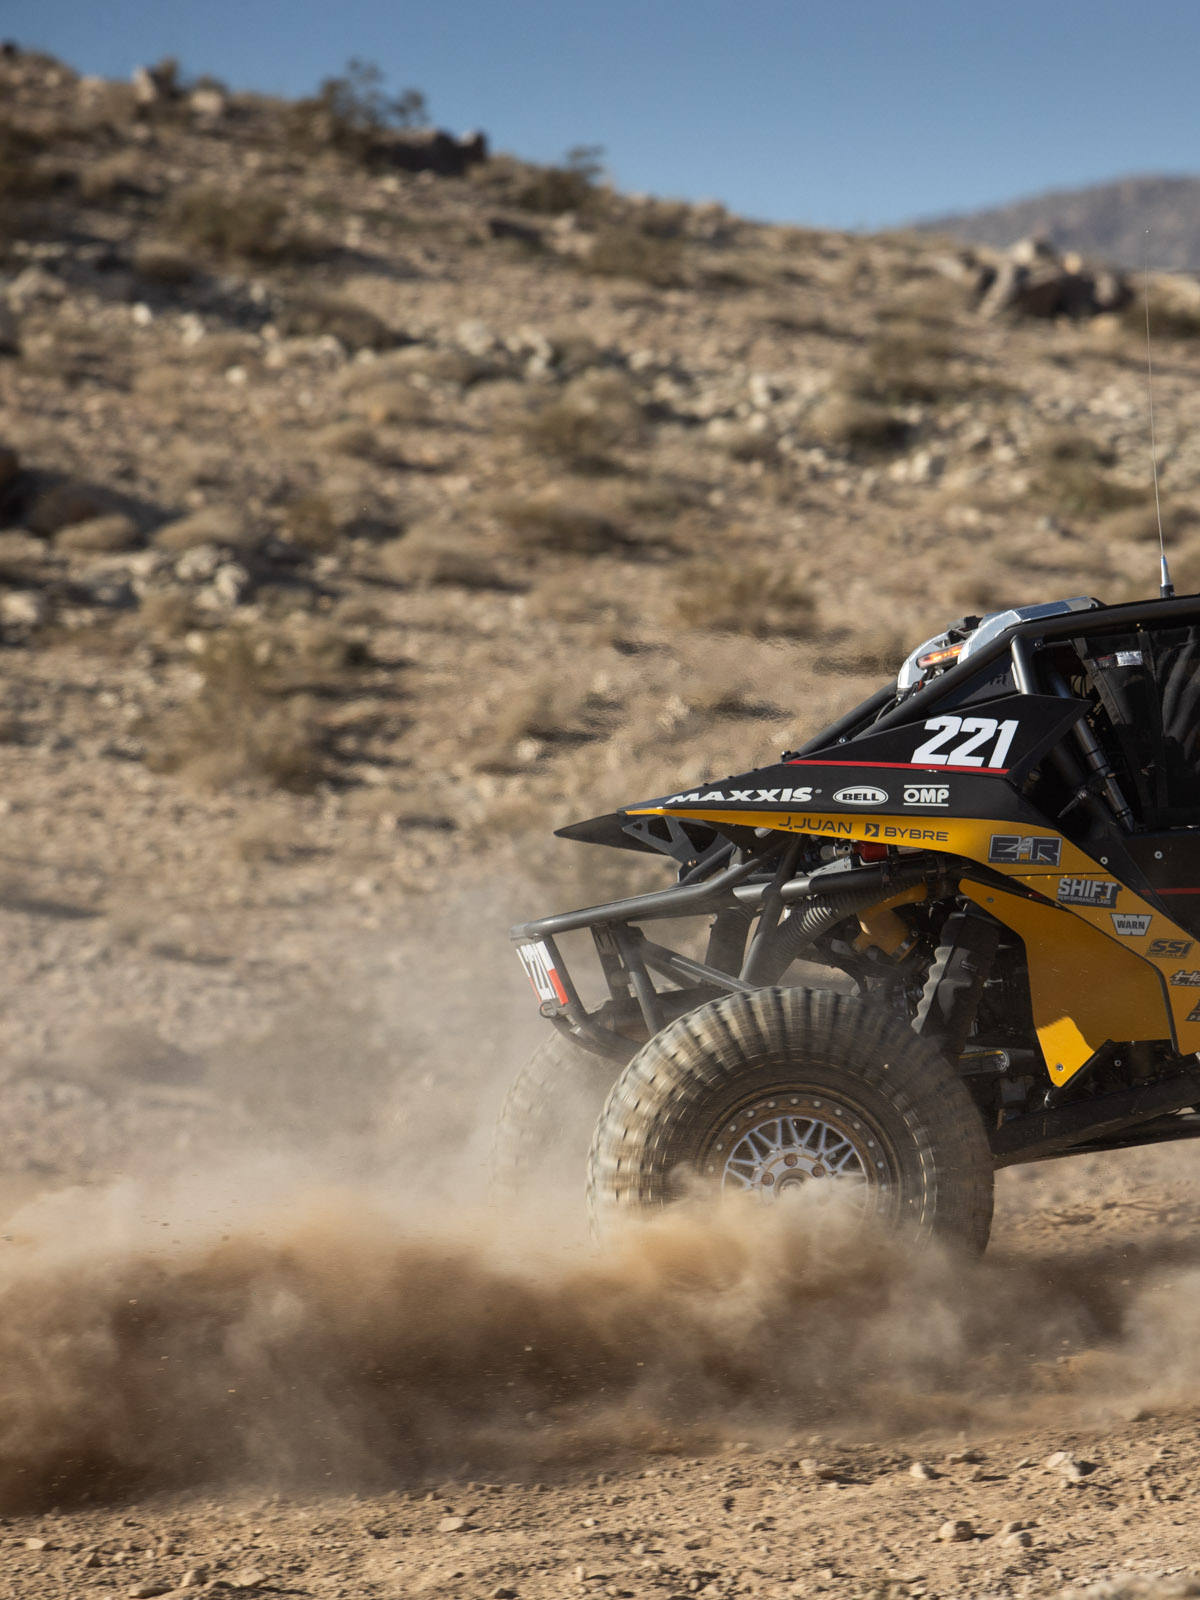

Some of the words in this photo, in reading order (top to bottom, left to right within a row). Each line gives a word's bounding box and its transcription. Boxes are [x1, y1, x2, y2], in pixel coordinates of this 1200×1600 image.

[910, 715, 1020, 769] 221
[665, 787, 813, 804] MAXXIS
[841, 790, 881, 802] BELL
[903, 788, 949, 803] OMP
[884, 827, 949, 842] BYBRE
[1057, 878, 1117, 899] SHIFT
[1117, 920, 1145, 930] WARN
